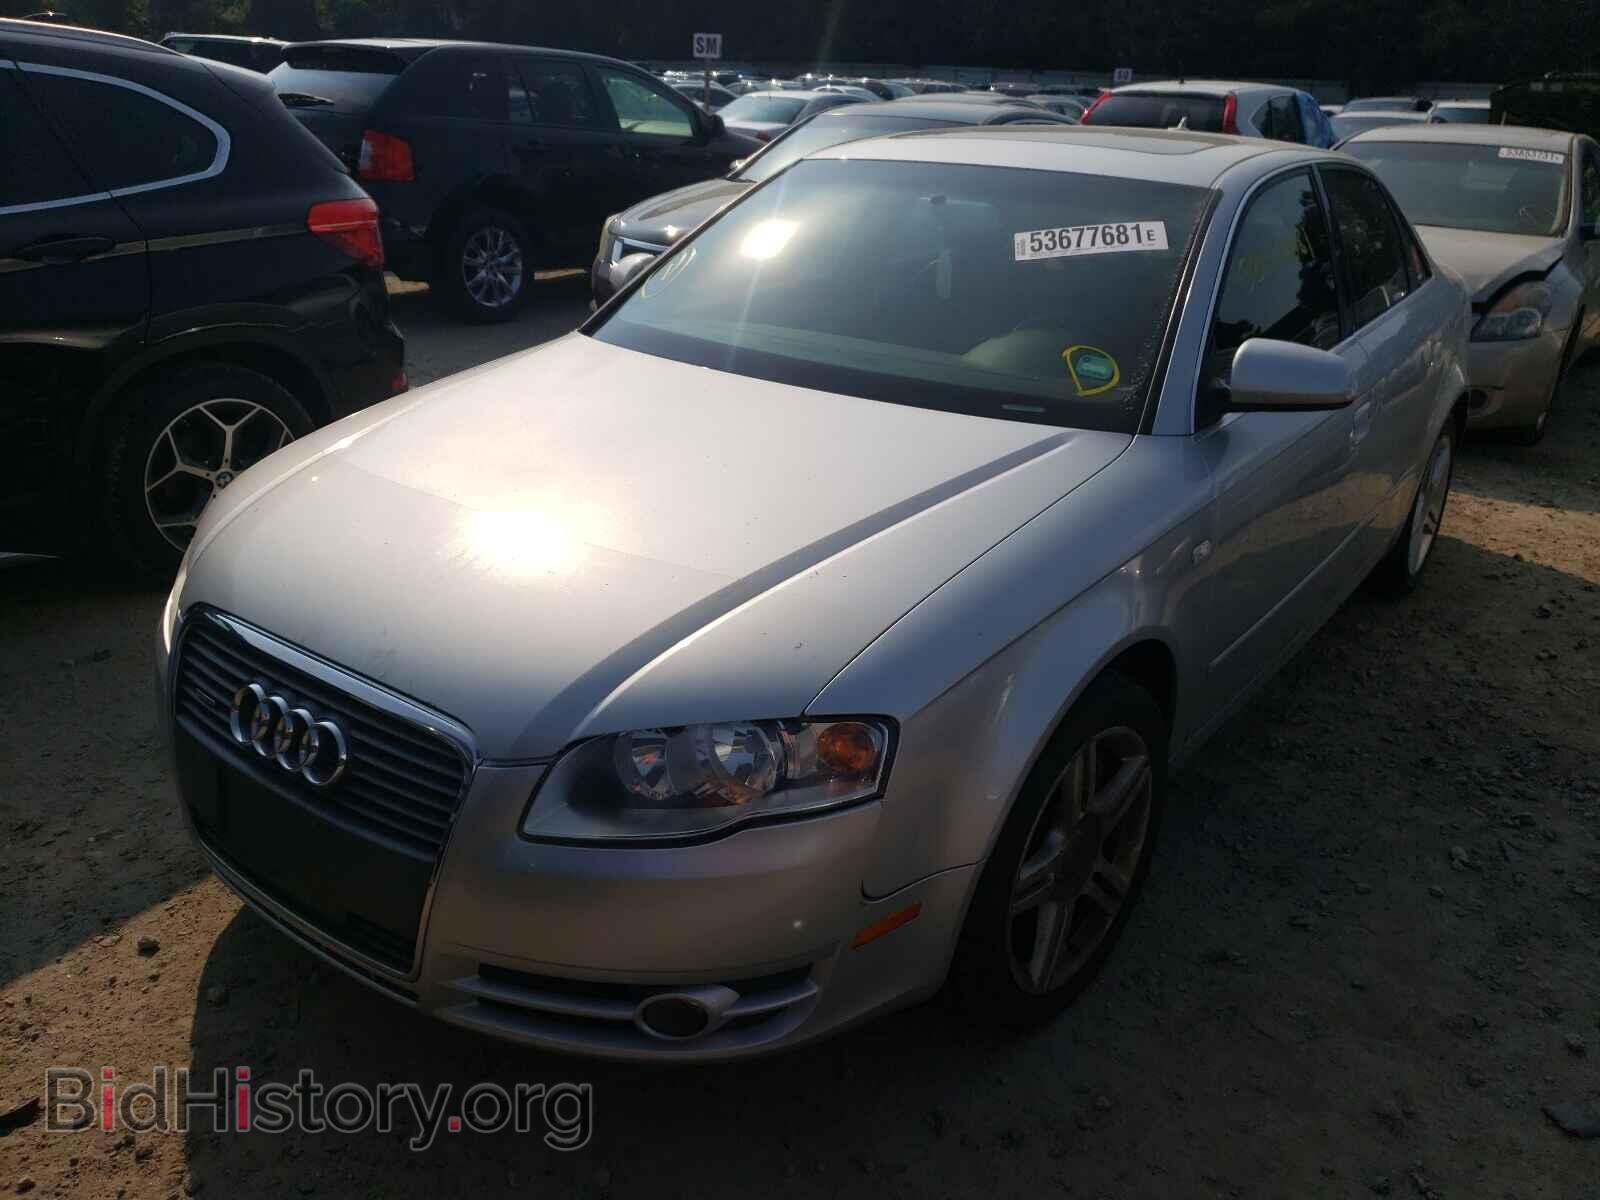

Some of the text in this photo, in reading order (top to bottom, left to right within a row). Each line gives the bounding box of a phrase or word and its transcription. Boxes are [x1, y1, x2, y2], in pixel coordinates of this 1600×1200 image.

[696, 37, 717, 54] SM
[1030, 223, 1142, 252] 53677681
[1146, 229, 1156, 241] E
